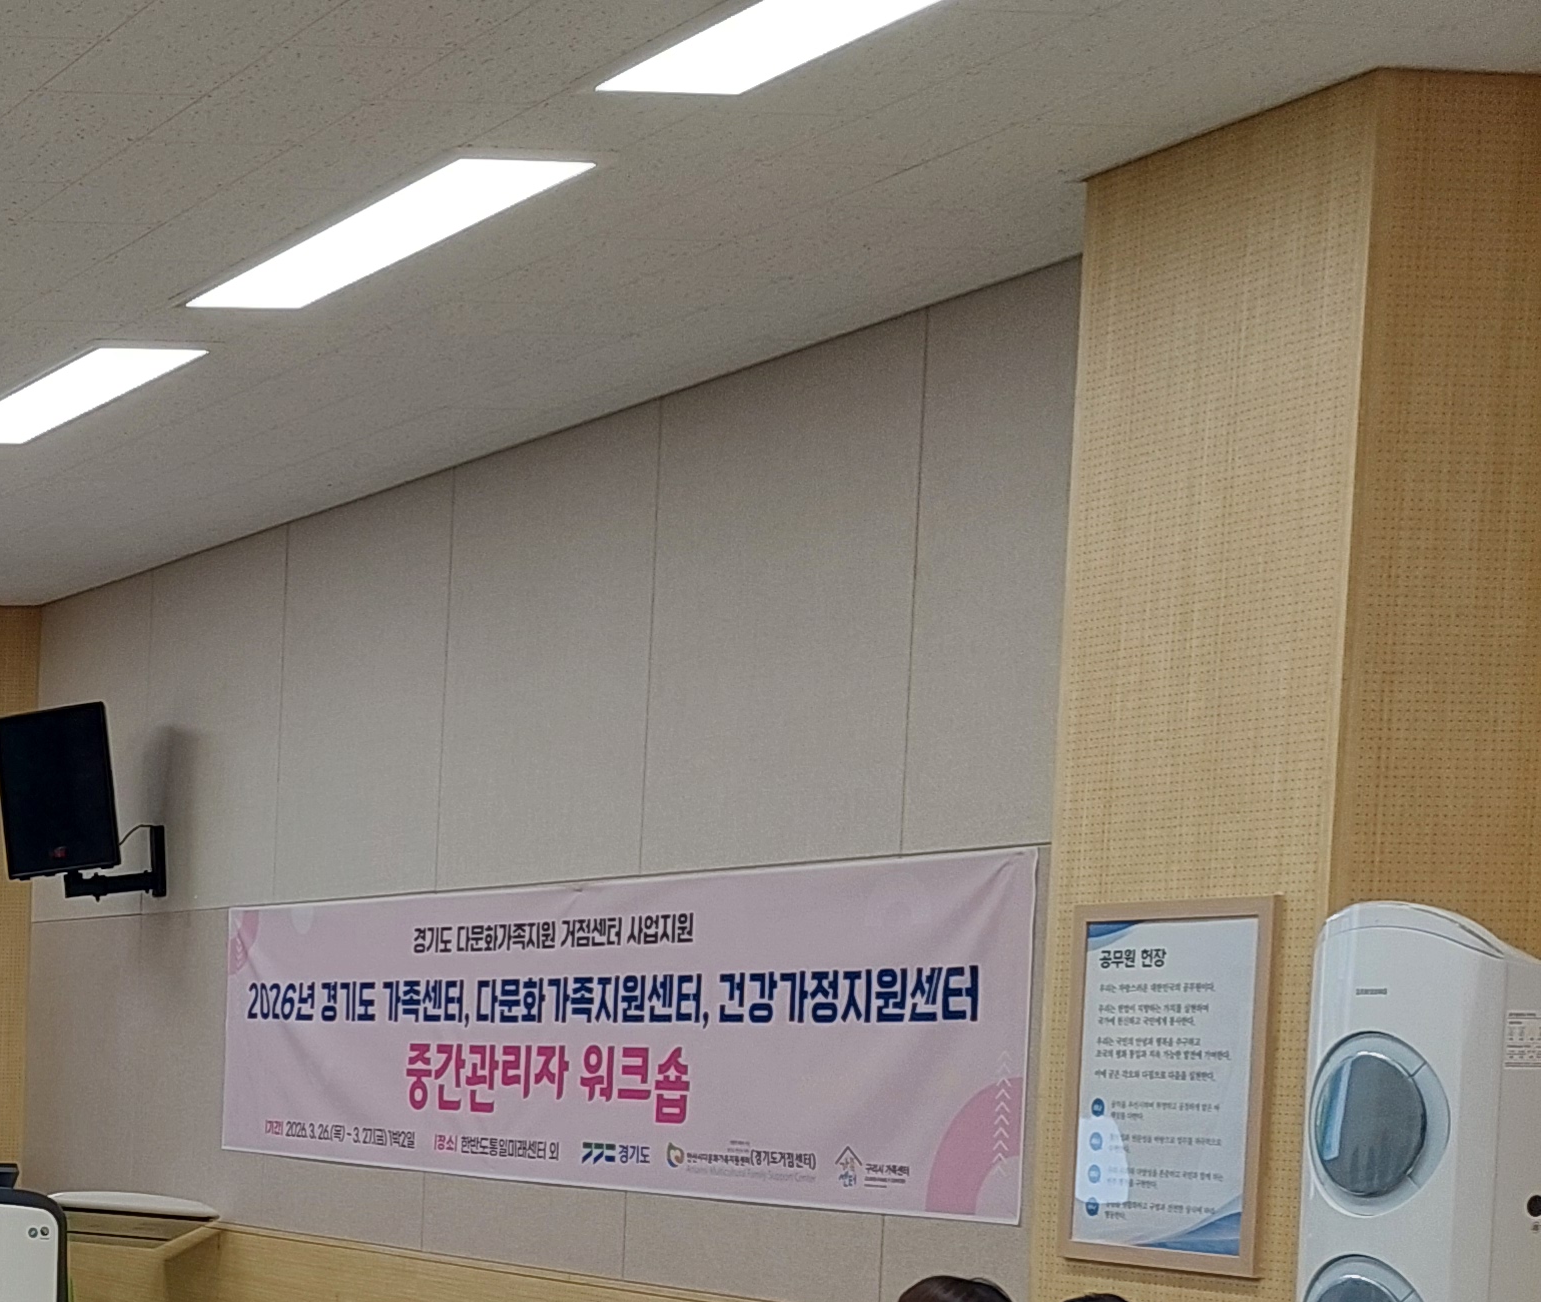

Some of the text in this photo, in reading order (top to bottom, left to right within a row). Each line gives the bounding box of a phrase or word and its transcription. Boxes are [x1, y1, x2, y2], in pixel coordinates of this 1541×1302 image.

[413, 913, 694, 954] 경기도 다문화가족지원 거점센터 사업지원
[1099, 948, 1167, 969] 공무원 헌장
[247, 981, 315, 1022] 2026년
[321, 980, 376, 1022] 경기도
[382, 979, 470, 1028] 가족센터,
[718, 964, 979, 1024] 건강가정지원센터
[406, 1043, 691, 1124] 중간관리자 워크숍
[461, 1136, 546, 1159] 한반도통일미래센터
[549, 1141, 559, 1161] 외
[618, 1144, 650, 1164] 경기도
